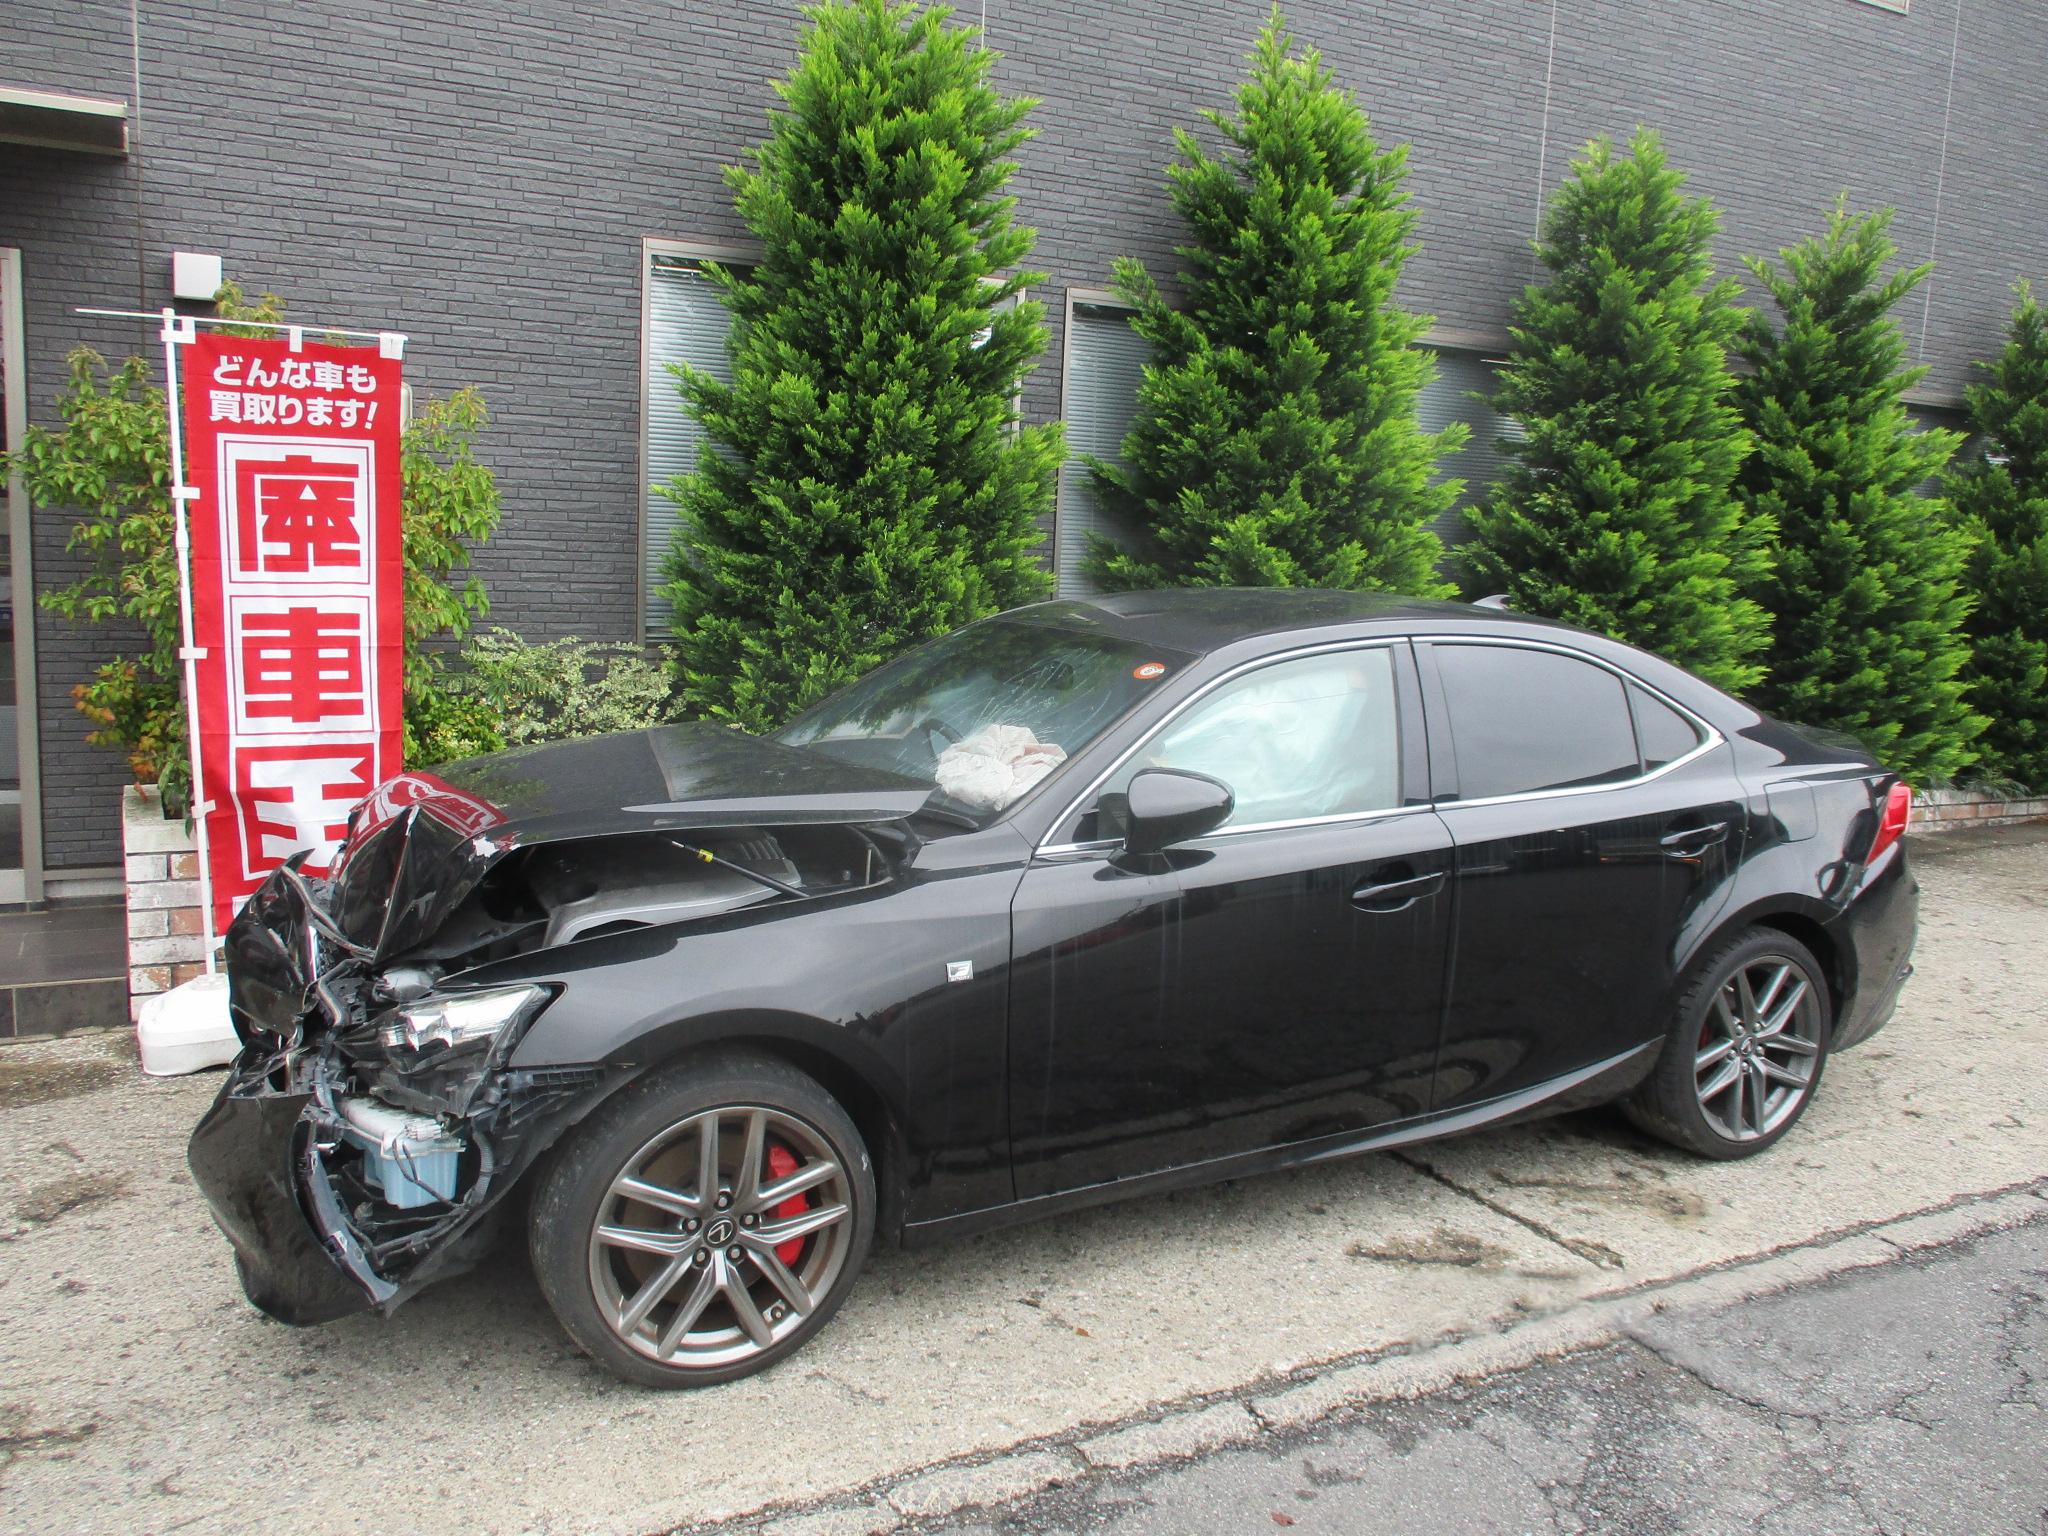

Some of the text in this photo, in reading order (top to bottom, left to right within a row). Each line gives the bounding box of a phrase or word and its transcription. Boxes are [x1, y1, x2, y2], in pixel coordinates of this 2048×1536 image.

[213, 355, 377, 394] どんな車も
[209, 390, 378, 429] 買取ります!
